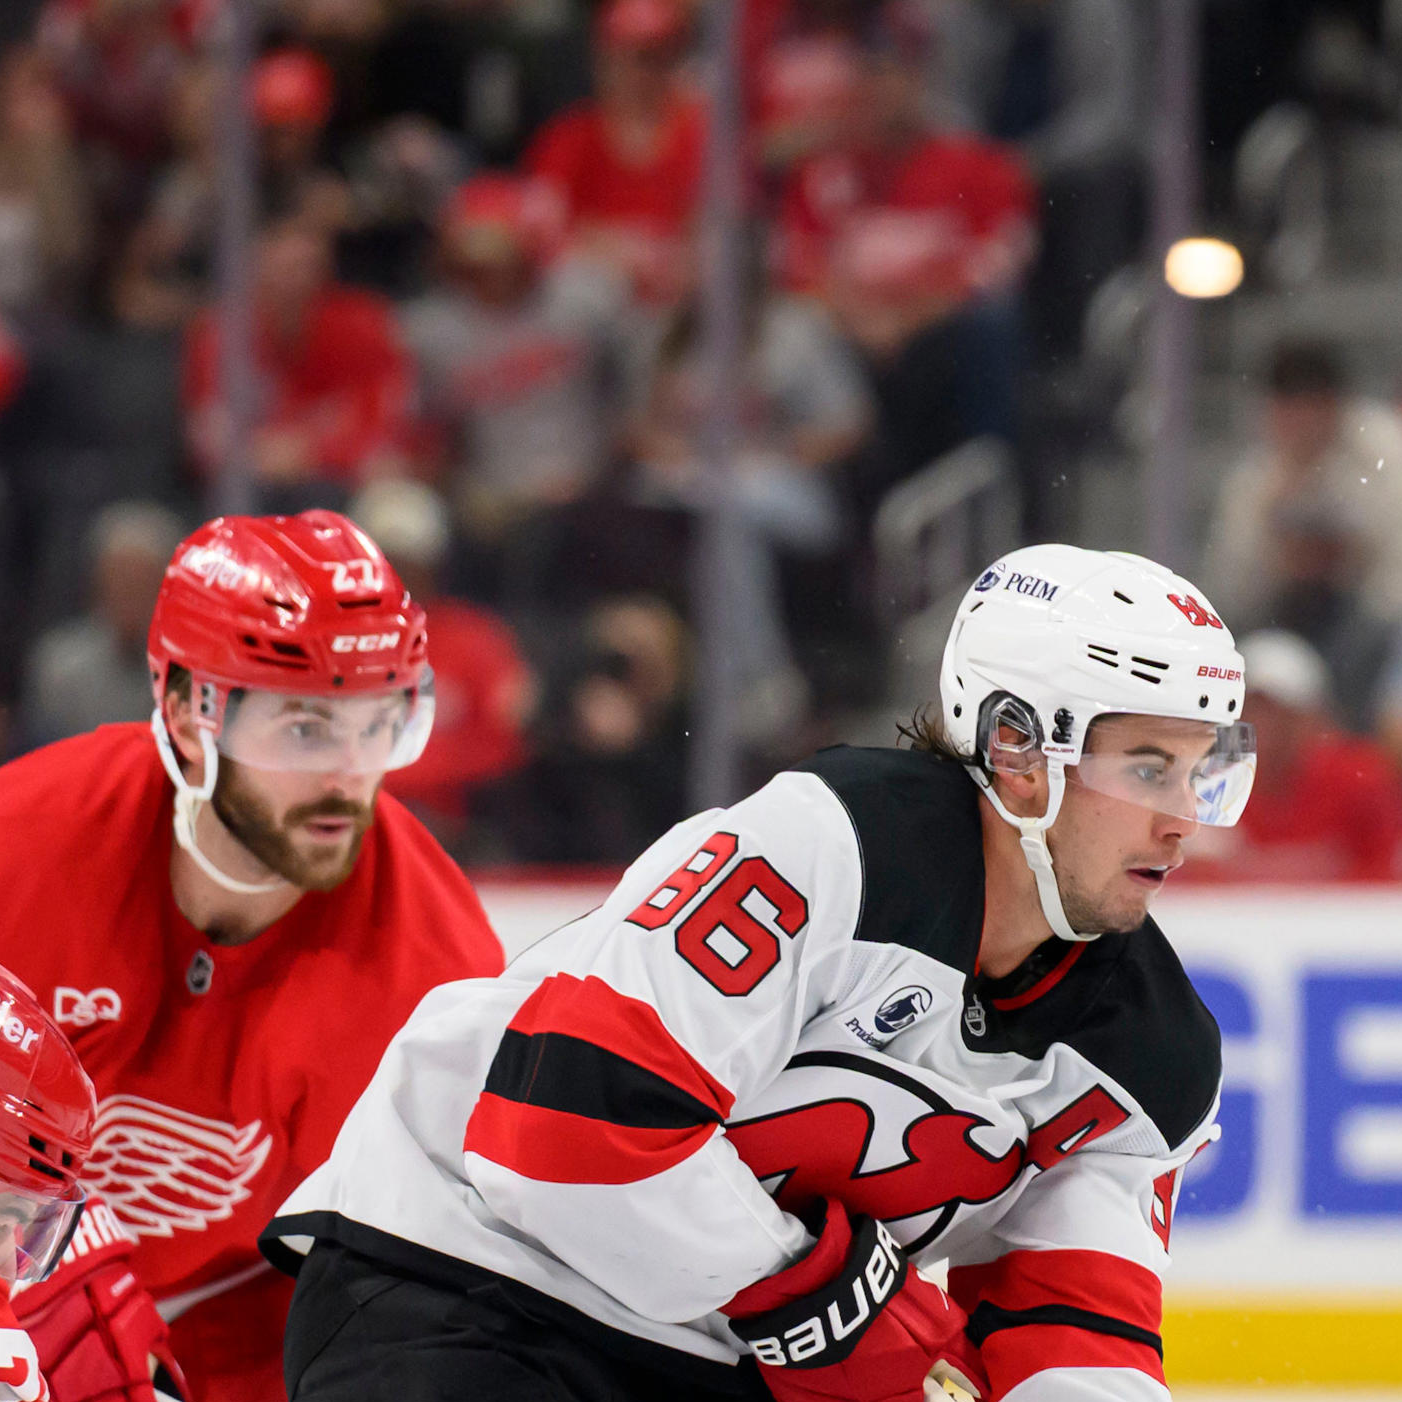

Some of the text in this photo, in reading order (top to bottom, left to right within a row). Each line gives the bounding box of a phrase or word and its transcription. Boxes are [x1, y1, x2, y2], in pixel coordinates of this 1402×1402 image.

[323, 558, 384, 592] 27
[1003, 573, 1059, 601] PGIM
[331, 631, 402, 653] CCM
[1196, 665, 1242, 682] BAUER
[625, 831, 809, 997] 86
[747, 1219, 902, 1367] BAUER
